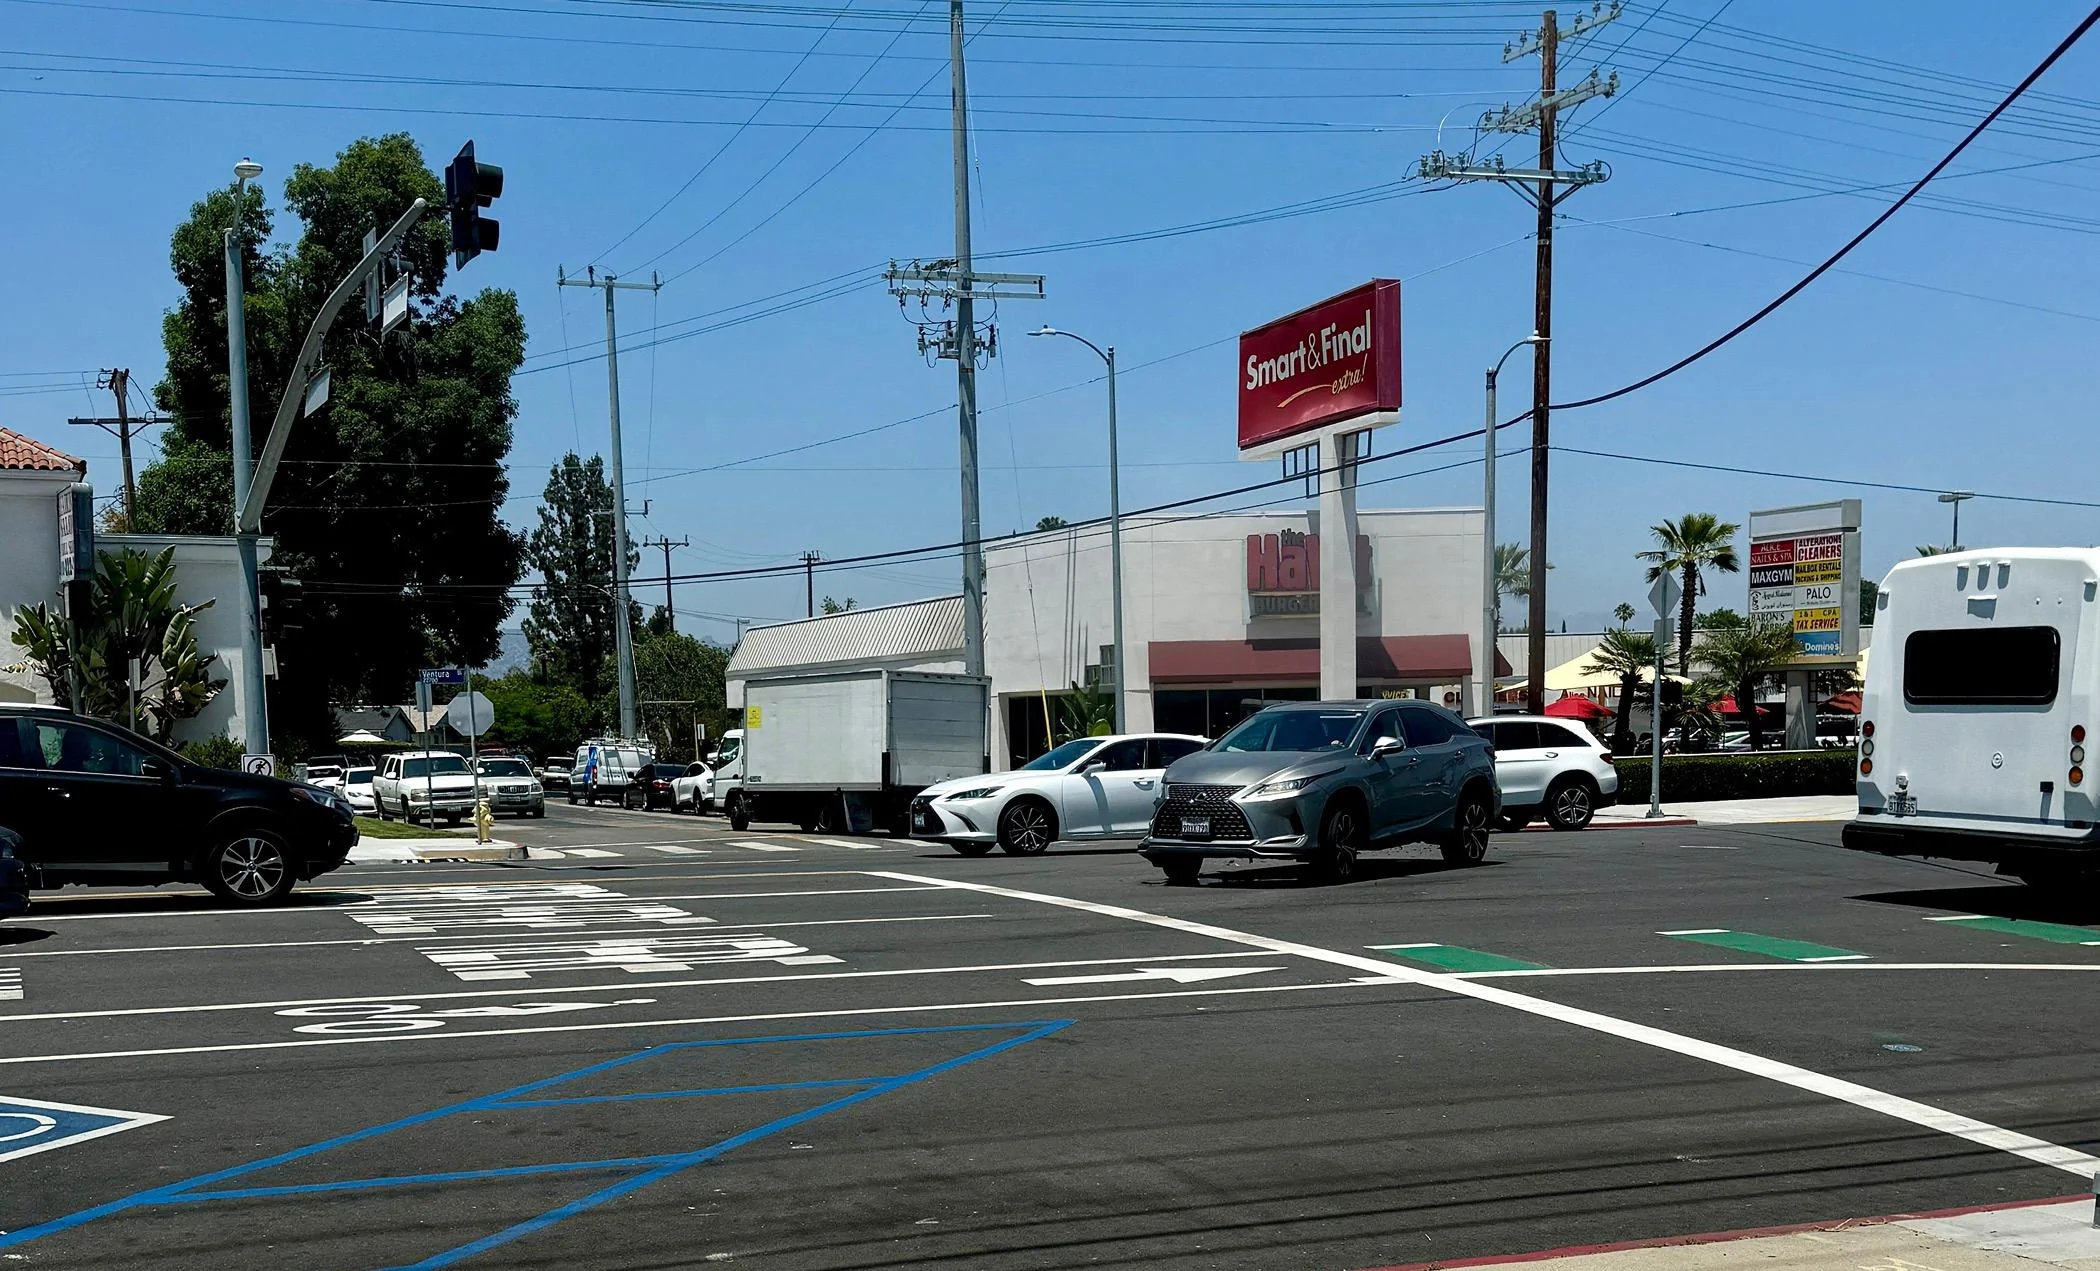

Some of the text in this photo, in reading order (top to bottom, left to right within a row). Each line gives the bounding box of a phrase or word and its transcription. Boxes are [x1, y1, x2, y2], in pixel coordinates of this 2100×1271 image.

[1246, 340, 1306, 391] Smart
[1320, 309, 1371, 366] Final
[1331, 353, 1368, 395] extra!
[1751, 552, 1793, 564] NAILS & SPA
[1798, 544, 1842, 562] CLEANERS
[1751, 568, 1793, 585] MAXGYM
[1806, 586, 1831, 600] PALO
[1796, 617, 1839, 631] TAX SERVICE
[1805, 641, 1839, 652] Domino's
